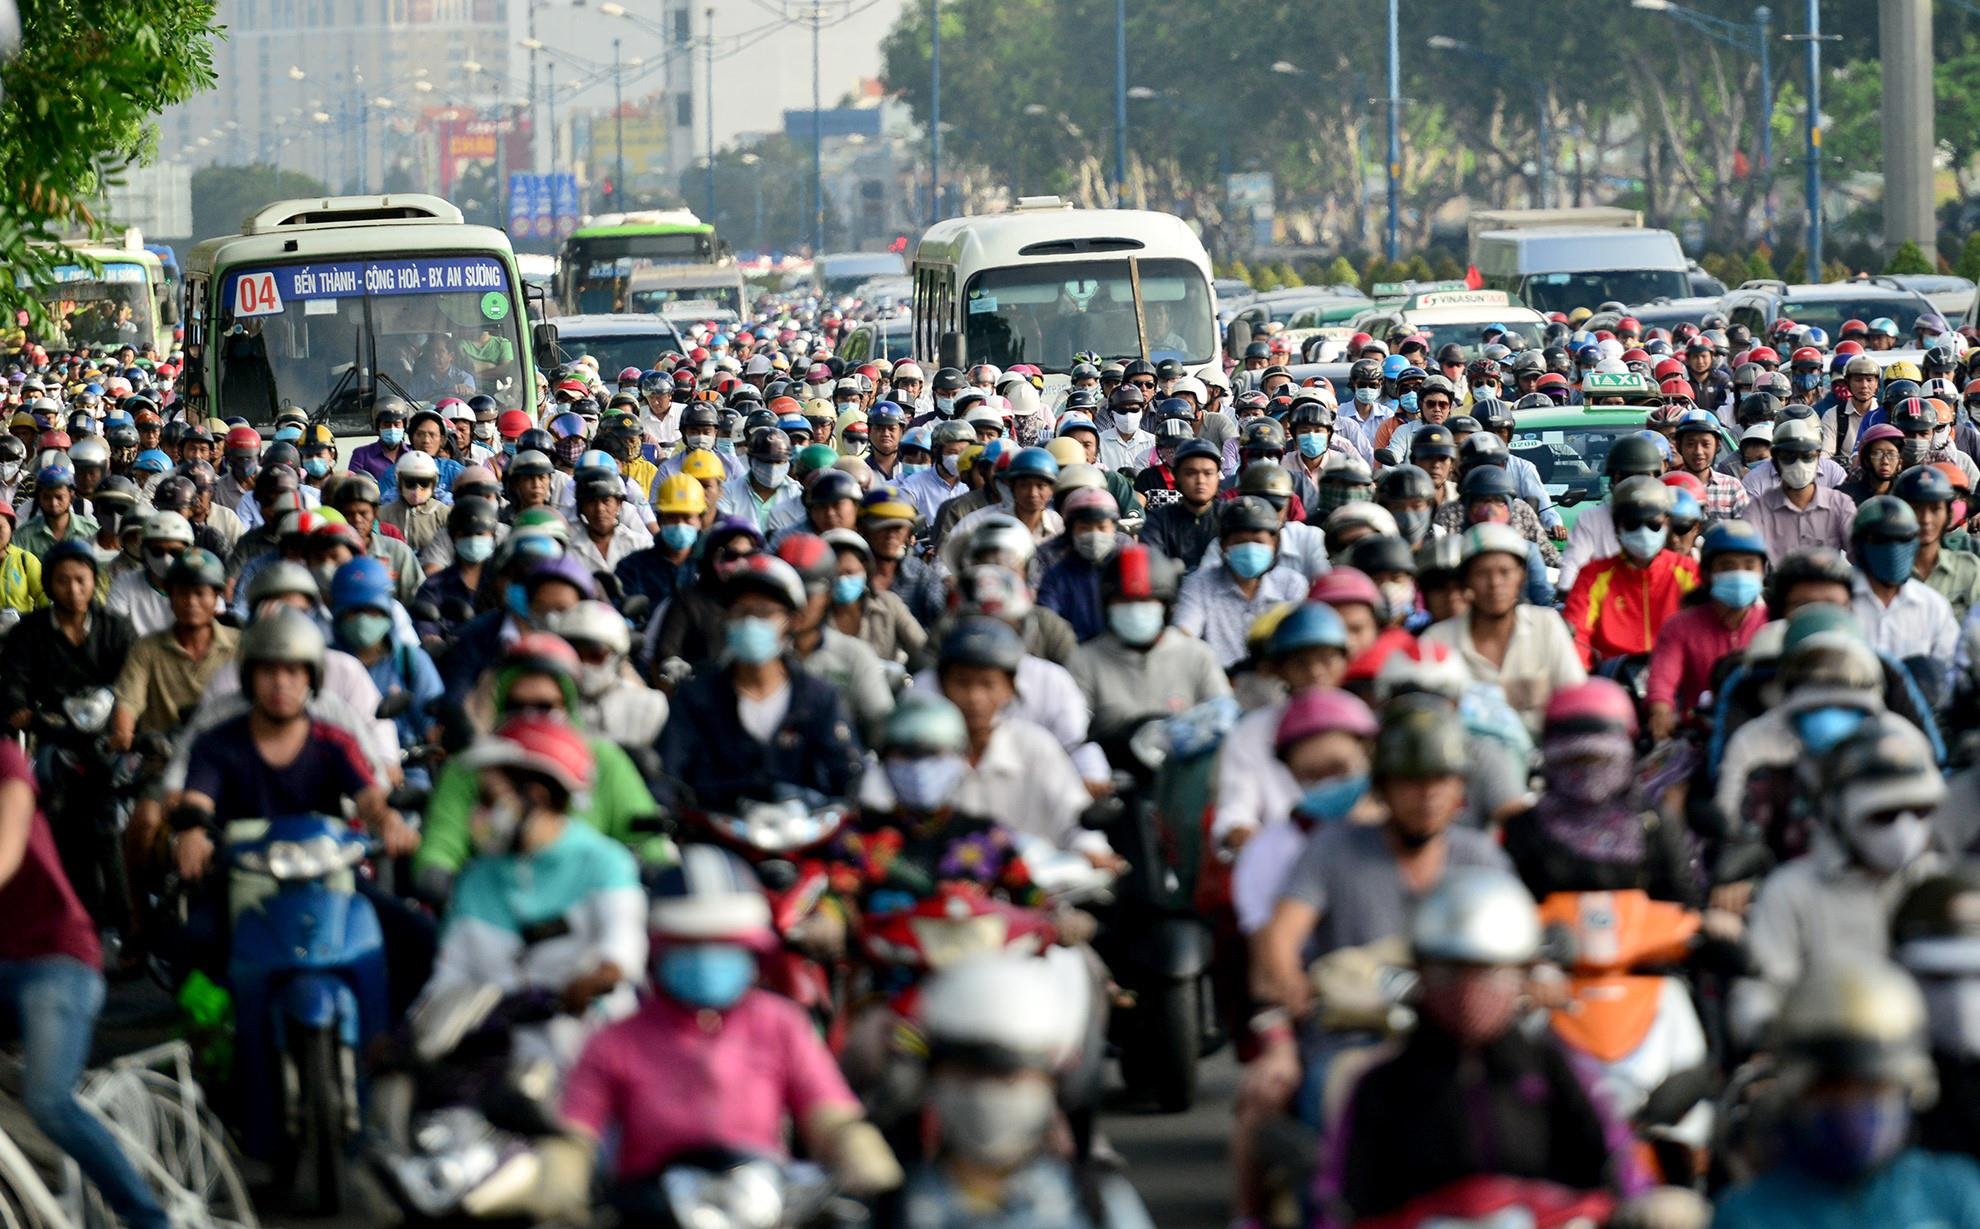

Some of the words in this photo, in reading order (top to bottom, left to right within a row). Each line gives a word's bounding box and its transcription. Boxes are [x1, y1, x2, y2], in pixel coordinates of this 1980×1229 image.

[240, 276, 276, 312] 04
[294, 266, 317, 294] BẾN
[319, 267, 356, 293] THÀNH
[365, 265, 394, 294] CỘNG
[398, 263, 421, 288] HOÀ
[428, 267, 444, 287] BX
[447, 267, 462, 287] AN
[465, 263, 501, 287] SƯƠNG
